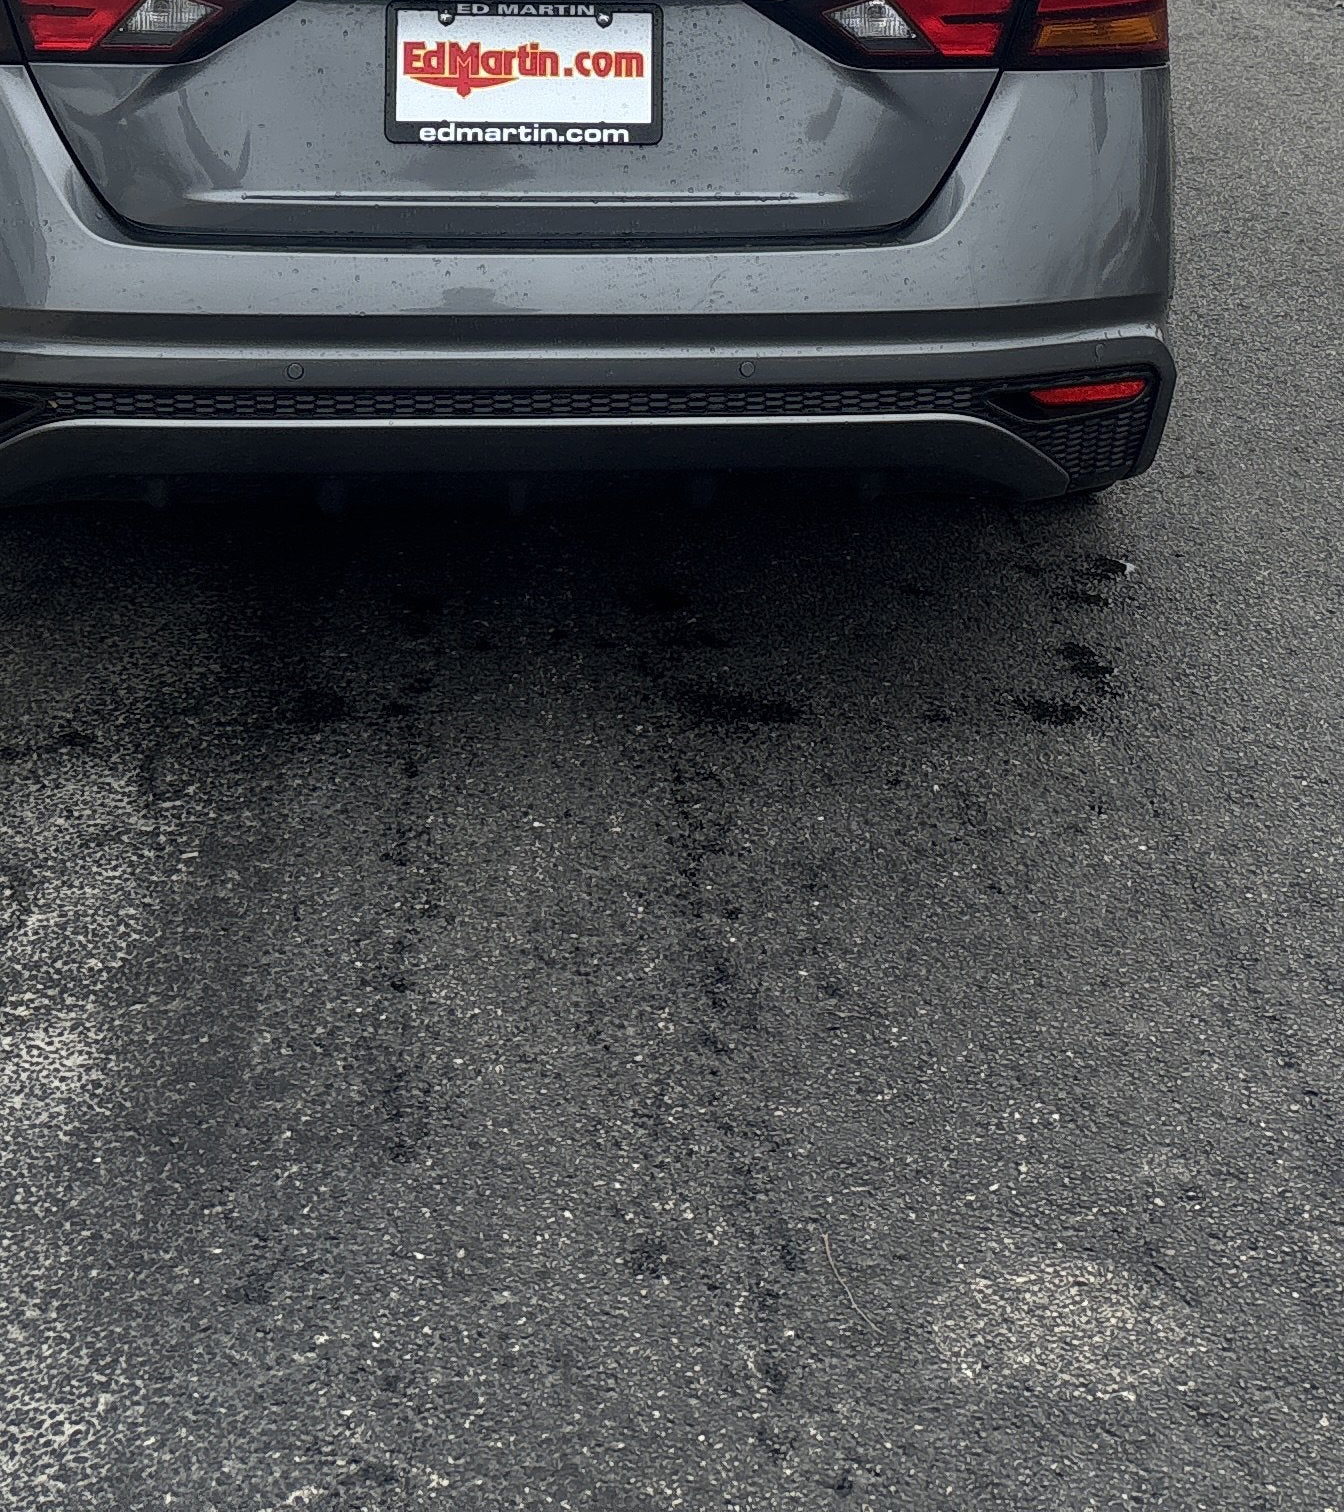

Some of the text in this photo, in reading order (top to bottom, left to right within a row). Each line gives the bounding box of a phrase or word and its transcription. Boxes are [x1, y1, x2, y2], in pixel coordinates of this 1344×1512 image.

[456, 3, 596, 16] ED MARTIN
[402, 40, 645, 79] EdMartin.com
[419, 122, 631, 144] edmartin.com
